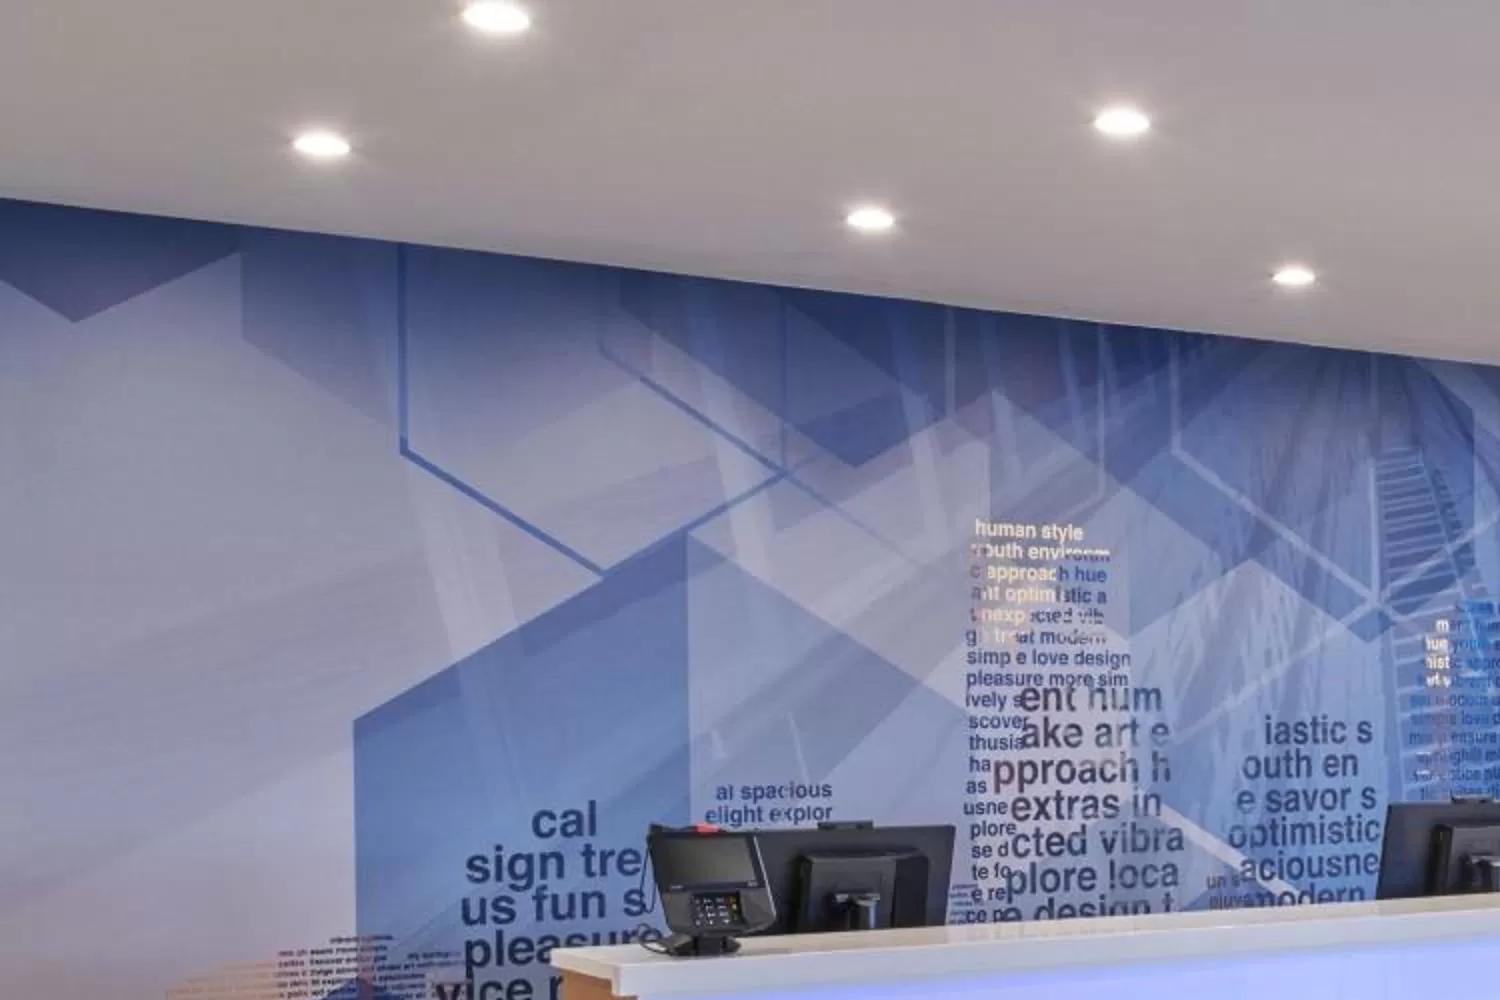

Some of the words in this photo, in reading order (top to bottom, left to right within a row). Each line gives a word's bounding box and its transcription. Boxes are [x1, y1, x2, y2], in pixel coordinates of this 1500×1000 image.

[975, 516, 1036, 539] human
[1041, 523, 1084, 544] style
[987, 563, 1069, 583] approach
[1075, 564, 1107, 583] hue
[1005, 584, 1092, 604] optimistic
[1032, 649, 1069, 666] love
[1073, 649, 1132, 670] design
[966, 669, 1044, 691] pleasure
[1049, 672, 1095, 688] more
[1097, 671, 1129, 687] sim
[1020, 683, 1077, 712] ent
[968, 714, 1029, 730] scover
[1022, 716, 1083, 748] ake
[1095, 717, 1140, 748] art
[1150, 722, 1170, 748] e
[1264, 714, 1347, 745] iastic
[1356, 720, 1374, 745] s
[968, 755, 991, 773] ha
[993, 750, 1139, 794] pproach
[1151, 750, 1172, 783] h
[1242, 748, 1313, 780] outh
[1323, 753, 1359, 778] en
[740, 780, 833, 803] spacious
[966, 779, 987, 794] as
[1236, 790, 1256, 815] e
[1264, 786, 1352, 814] savor
[1360, 785, 1377, 810] s
[705, 804, 764, 828] elight
[769, 804, 833, 825] explor
[963, 799, 1008, 816] usne
[1010, 789, 1121, 823] extras
[1132, 786, 1162, 818] in
[531, 799, 597, 840] cal
[969, 821, 1017, 842] plore
[1228, 813, 1381, 850] optimistic
[970, 845, 993, 860] se
[997, 841, 1009, 858] d
[1011, 822, 1088, 859] cted
[1100, 821, 1185, 857] vibra
[465, 843, 566, 893] sign
[580, 842, 643, 879] tre
[971, 863, 989, 881] te
[1239, 850, 1380, 881] aciousne
[1005, 862, 1097, 904] plore
[460, 893, 517, 927] us
[531, 884, 606, 923] fun
[622, 888, 649, 918] s
